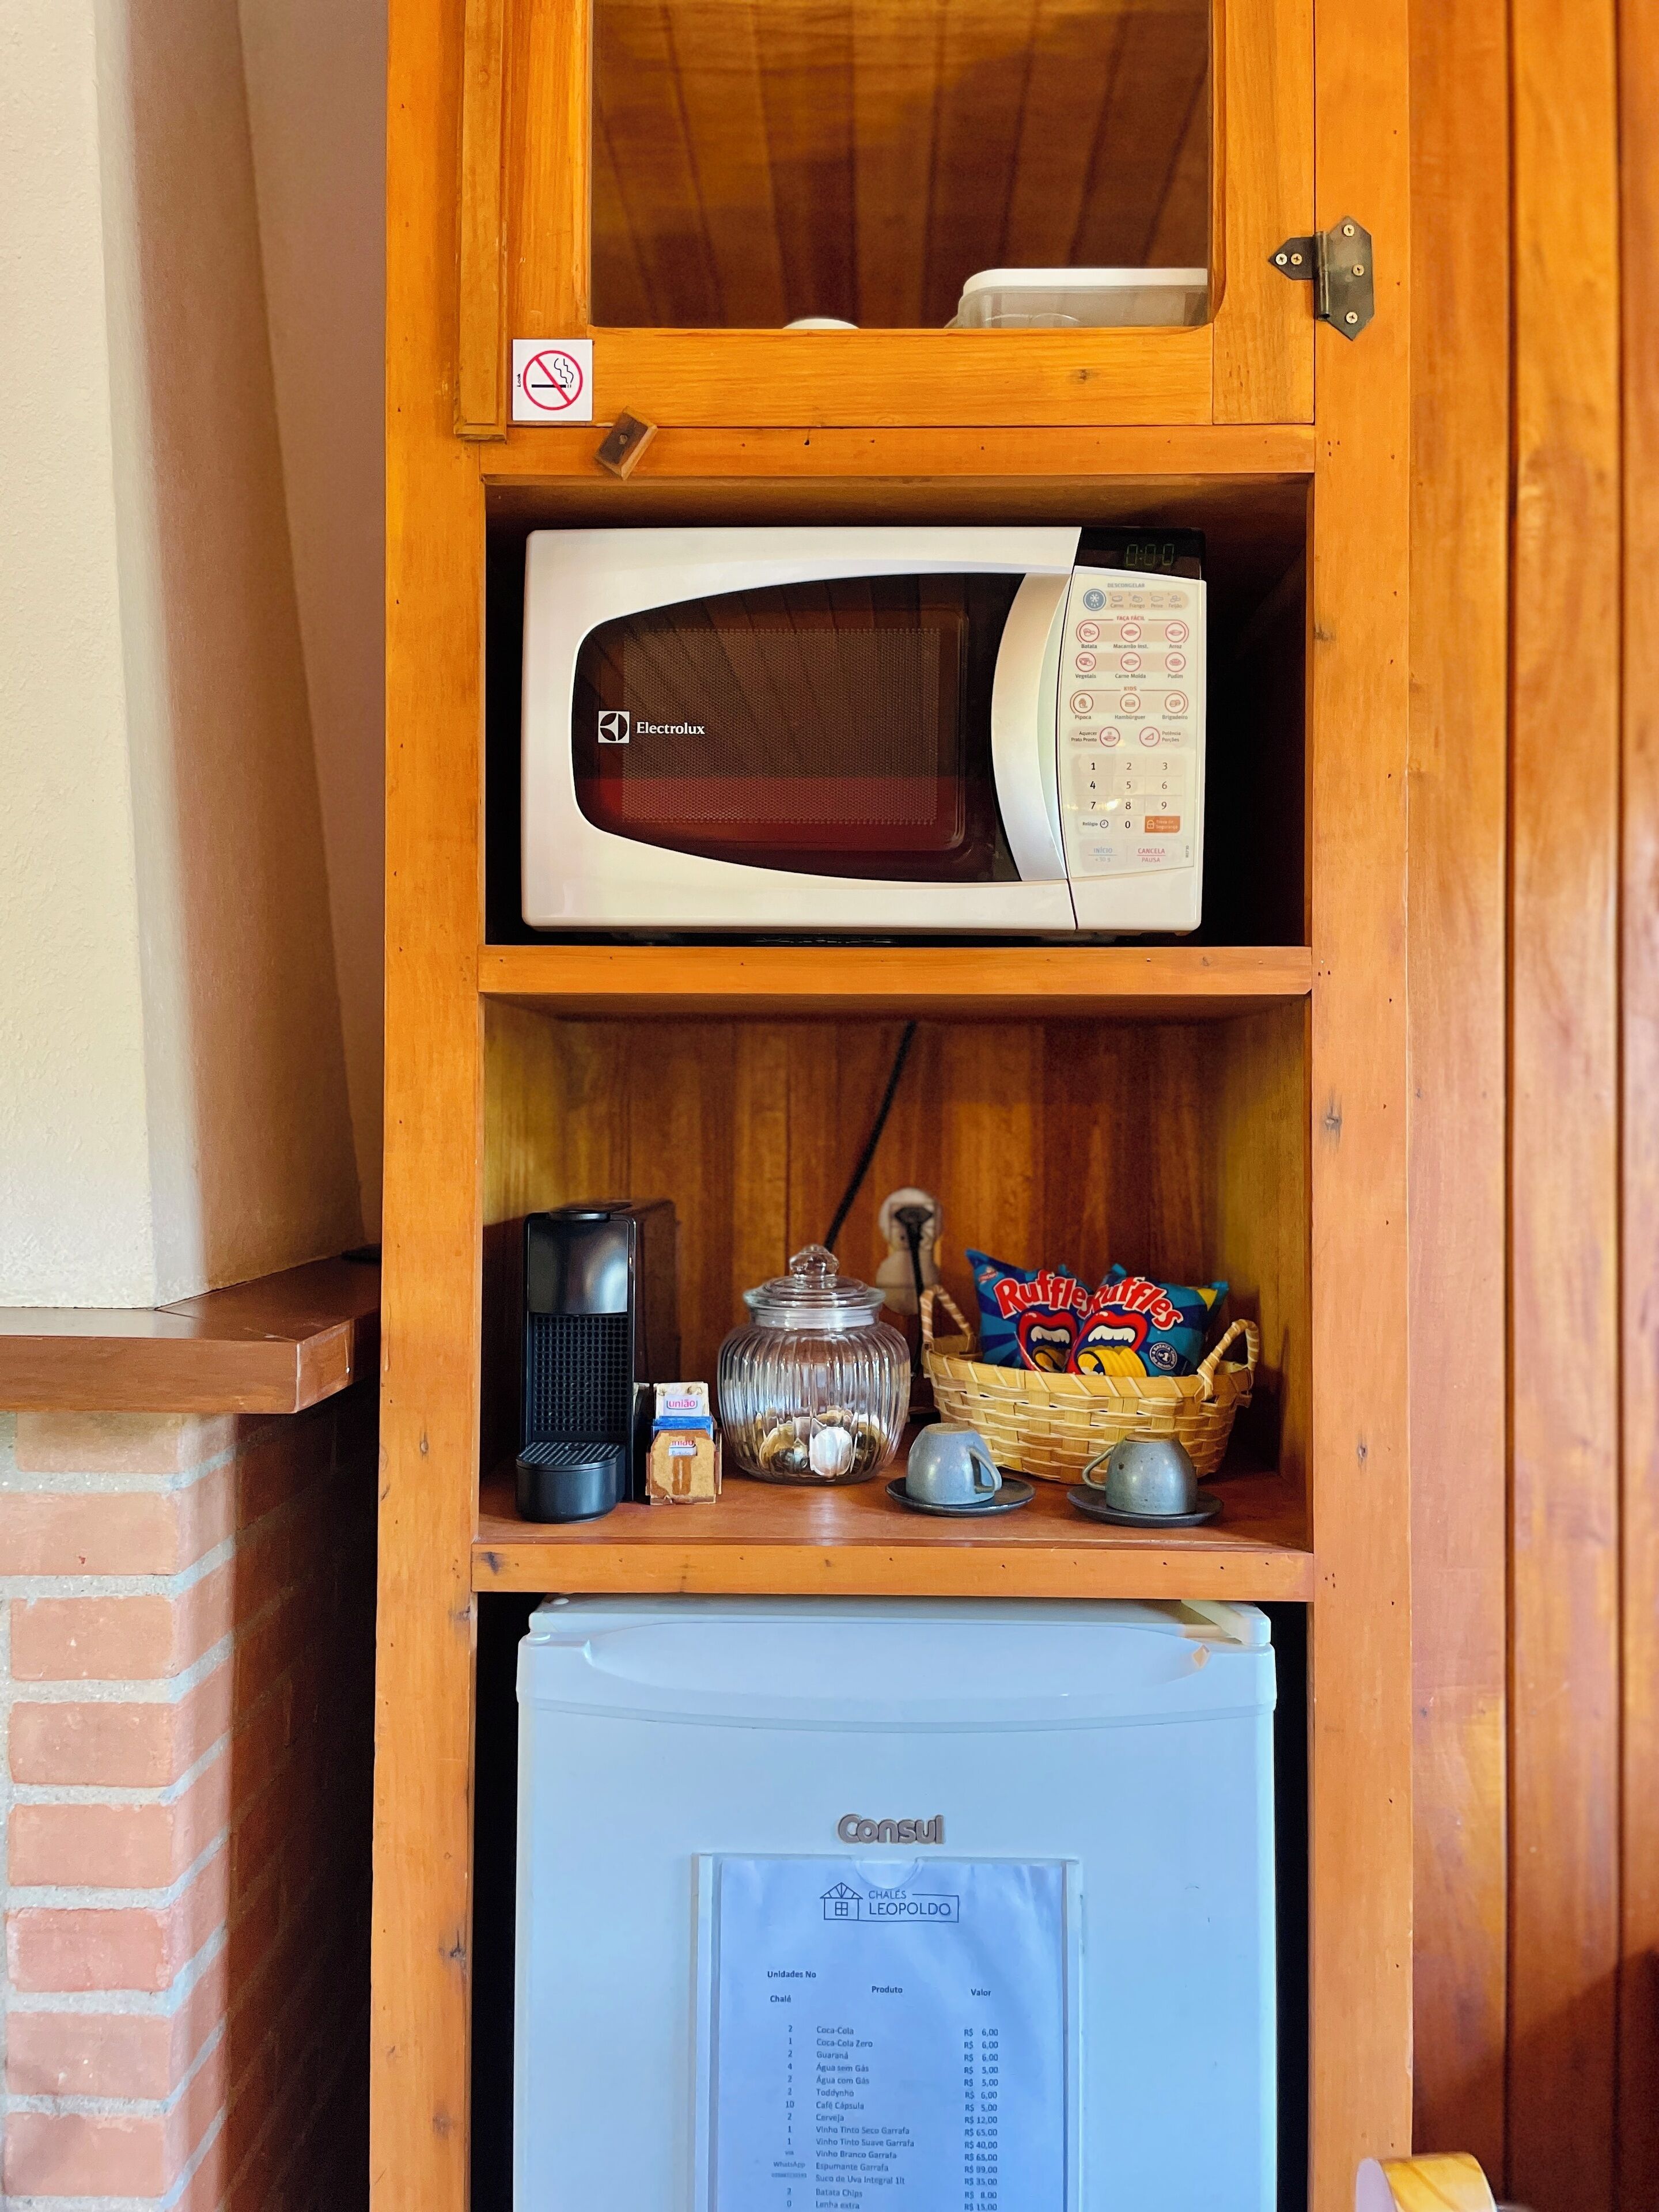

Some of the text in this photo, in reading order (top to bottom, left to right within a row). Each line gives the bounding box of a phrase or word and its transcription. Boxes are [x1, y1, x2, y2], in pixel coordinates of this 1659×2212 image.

[1126, 544, 1175, 566] 0:00
[637, 721, 705, 735] Electrolux
[1091, 762, 1096, 770] 1
[1126, 762, 1132, 770] 2
[1162, 762, 1168, 770] 3
[1090, 781, 1096, 789] 4
[1126, 781, 1131, 789] 5
[1162, 781, 1168, 789] 6
[1090, 801, 1096, 809] 7
[1126, 801, 1131, 809] 8
[1161, 801, 1167, 809] 9
[1125, 820, 1131, 828] 0
[993, 1269, 1092, 1320] Ruffles
[1089, 1277, 1184, 1331] Ruffles
[669, 1399, 695, 1407] união
[838, 1814, 944, 1844] Consul
[869, 1889, 907, 1899] CHALÉS
[869, 1903, 950, 1915] LEOPOLDO
[770, 1995, 791, 2003] Chalé
[816, 2026, 854, 2035] Coca-Cola
[964, 2028, 999, 2037] R$ 6,00
[816, 2039, 854, 2047] Coca-Cola
[964, 2041, 999, 2050] R$ 6,00
[816, 2051, 849, 2059] Guaraná
[964, 2054, 999, 2062] R$ 6,00
[816, 2063, 835, 2073] Água
[964, 2066, 999, 2074] R$ 5,00
[816, 2075, 835, 2085] Água
[964, 2078, 999, 2087] R$ 5,00
[816, 2089, 854, 2097] Toddynho
[965, 2091, 975, 2100] R$
[816, 2101, 864, 2110] Café Cápsula
[965, 2104, 997, 2112] R$ 5,00
[816, 2114, 844, 2122] Cerveja
[964, 2116, 998, 2124] R$ 12,00
[881, 2127, 910, 2135] Garrafa
[964, 2128, 998, 2137] R$ 65,00
[886, 2139, 915, 2147] Garrafa
[964, 2141, 998, 2149] R$ 40,00
[868, 2151, 897, 2159] Garrafa
[964, 2153, 974, 2161] R$
[816, 2163, 889, 2172] Espumante Garrafa
[964, 2165, 974, 2173] R$
[864, 2176, 893, 2186] Integral
[964, 2177, 974, 2186] R$
[842, 2189, 863, 2198] Chips
[964, 2191, 974, 2199] R$
[816, 2200, 838, 2209] Lenha
[964, 2203, 974, 2211] R$
